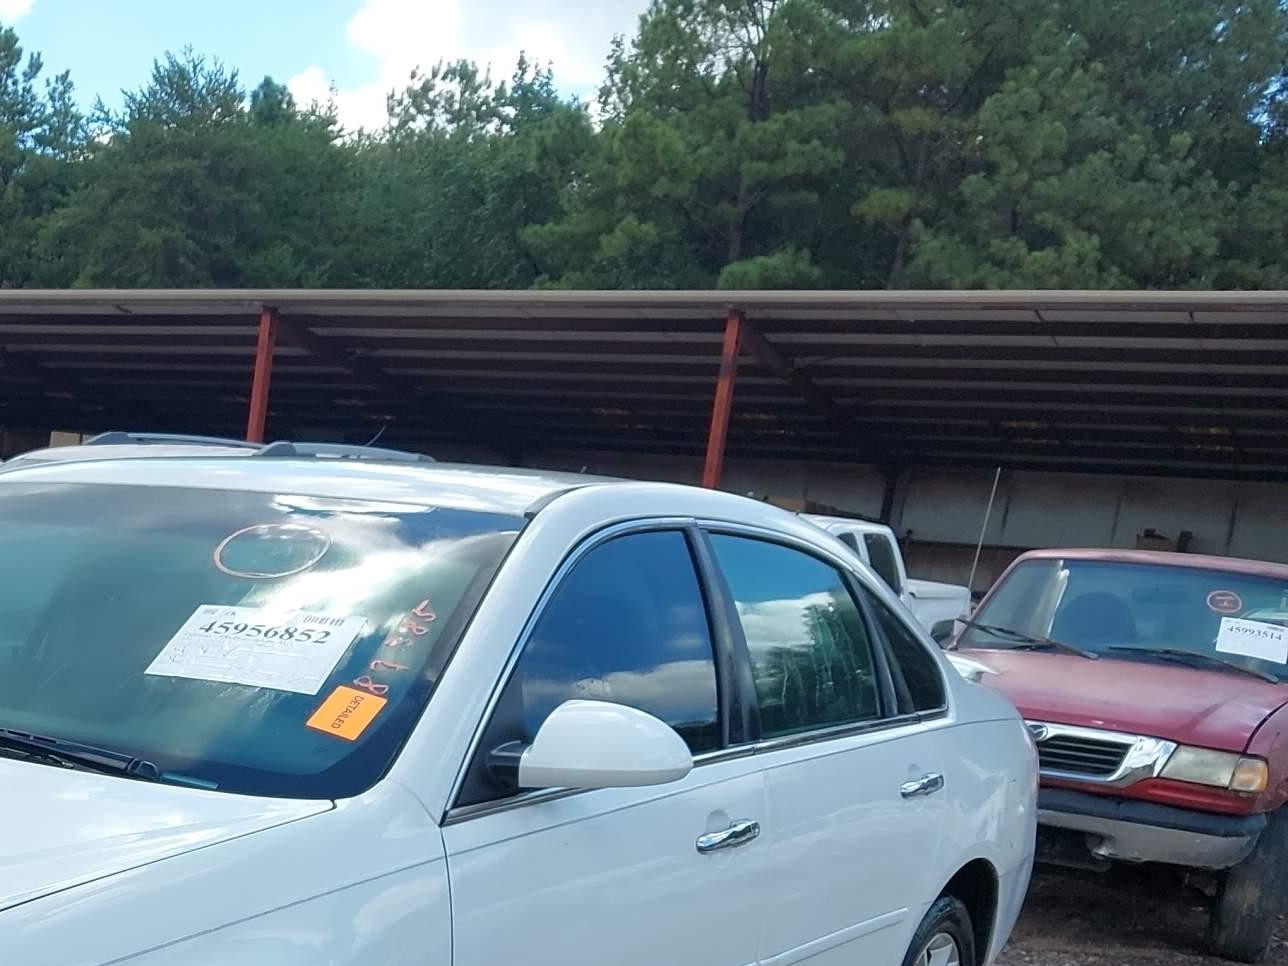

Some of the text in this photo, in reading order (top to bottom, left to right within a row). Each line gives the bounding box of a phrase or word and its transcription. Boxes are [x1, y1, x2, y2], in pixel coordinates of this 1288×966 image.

[200, 620, 331, 645] 45956852
[1227, 625, 1282, 641] 45993514
[331, 695, 364, 729] DETAILED
